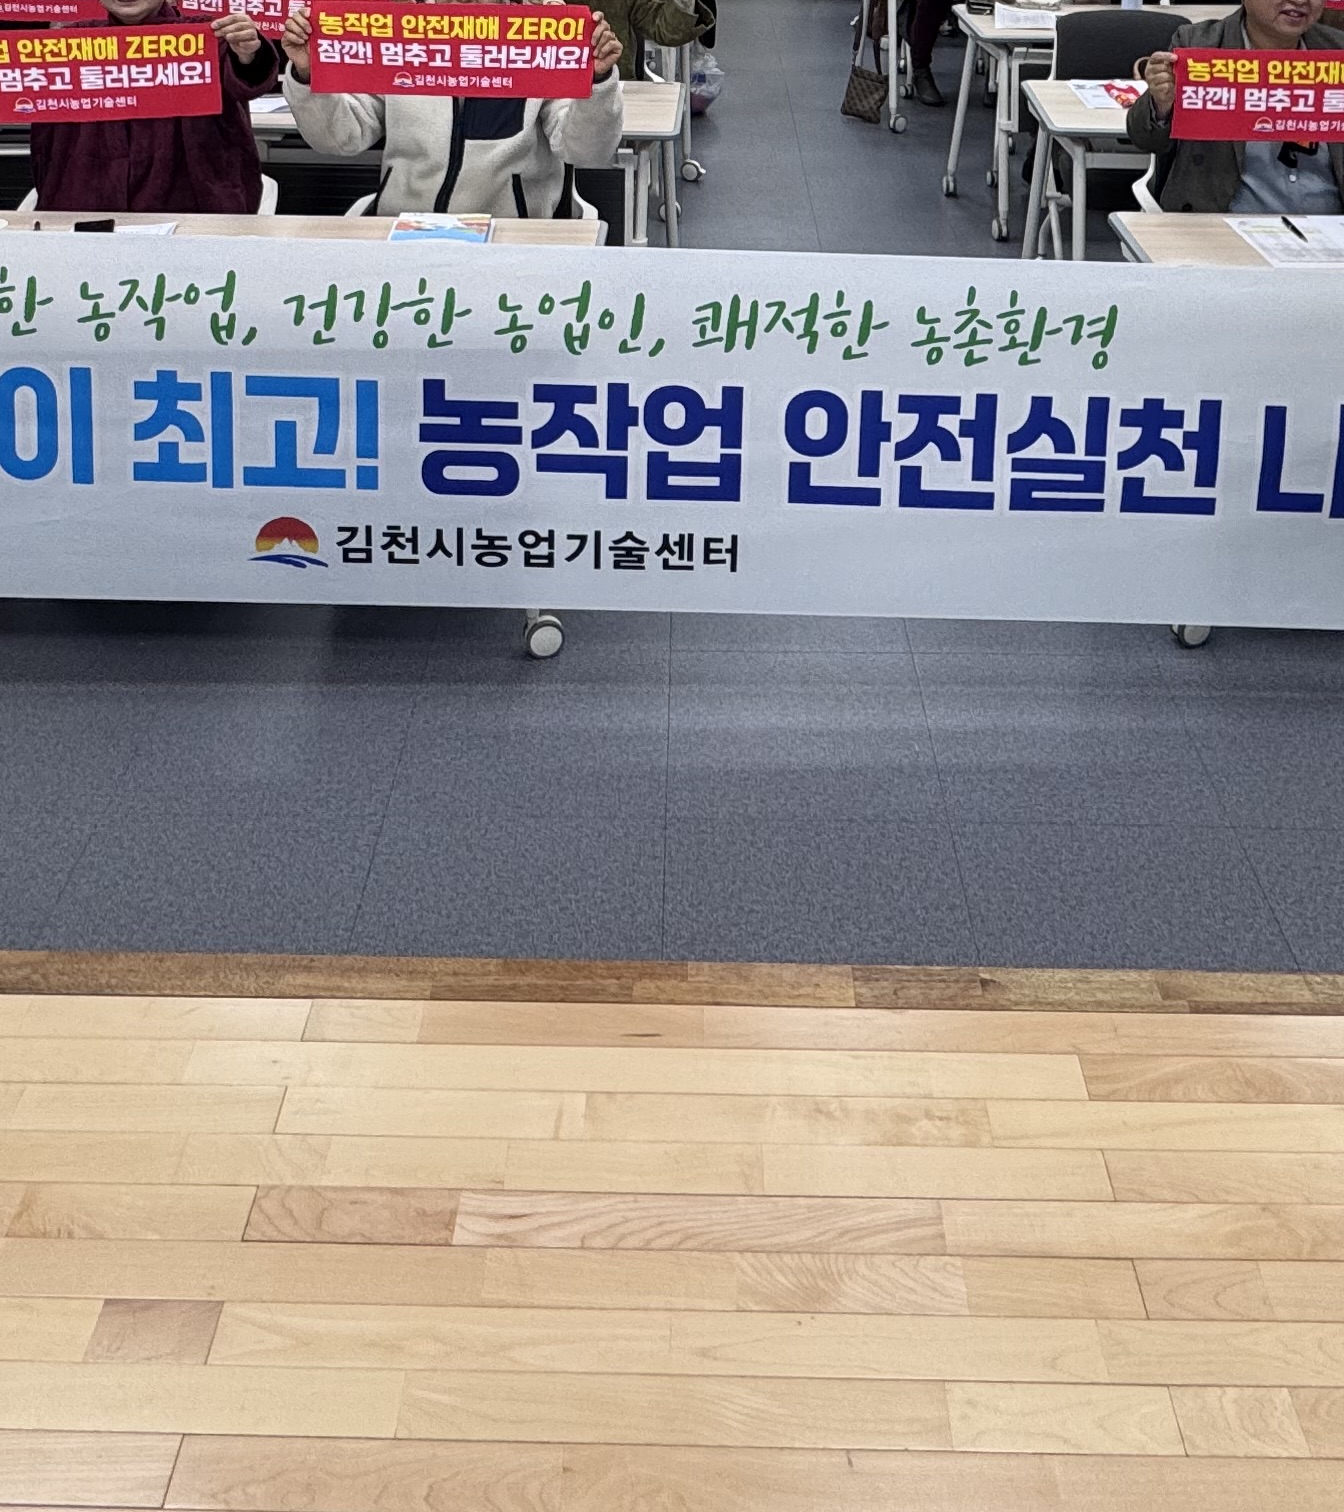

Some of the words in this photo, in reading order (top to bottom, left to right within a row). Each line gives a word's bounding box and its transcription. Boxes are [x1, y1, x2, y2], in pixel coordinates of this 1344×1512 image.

[319, 12, 393, 37] 농작업
[401, 15, 499, 40] 안전재해
[506, 17, 585, 41] ZERO!
[17, 37, 119, 63] 안전재해
[126, 34, 205, 58] ZERO!
[317, 39, 372, 64] 잠깐!
[380, 42, 452, 68] 멈추고
[460, 45, 589, 70] 둘러보세요!
[80, 61, 212, 89] 둘러보세요!
[415, 74, 512, 88] 김천시농업기술센터
[1187, 58, 1259, 83] 농작업
[1182, 87, 1236, 110] 잠깐!
[1244, 87, 1315, 112] 멈추고
[77, 271, 258, 345] 농작업,
[283, 278, 472, 349] 건강한
[494, 281, 665, 357] 농업인,
[692, 290, 890, 360] 쾌적한
[911, 286, 1119, 370] 농촌환경
[131, 368, 380, 492] 최고!
[419, 379, 743, 502] 농작업
[784, 389, 1222, 515] 안전실천
[336, 525, 739, 573] 김천시농업기술센터
